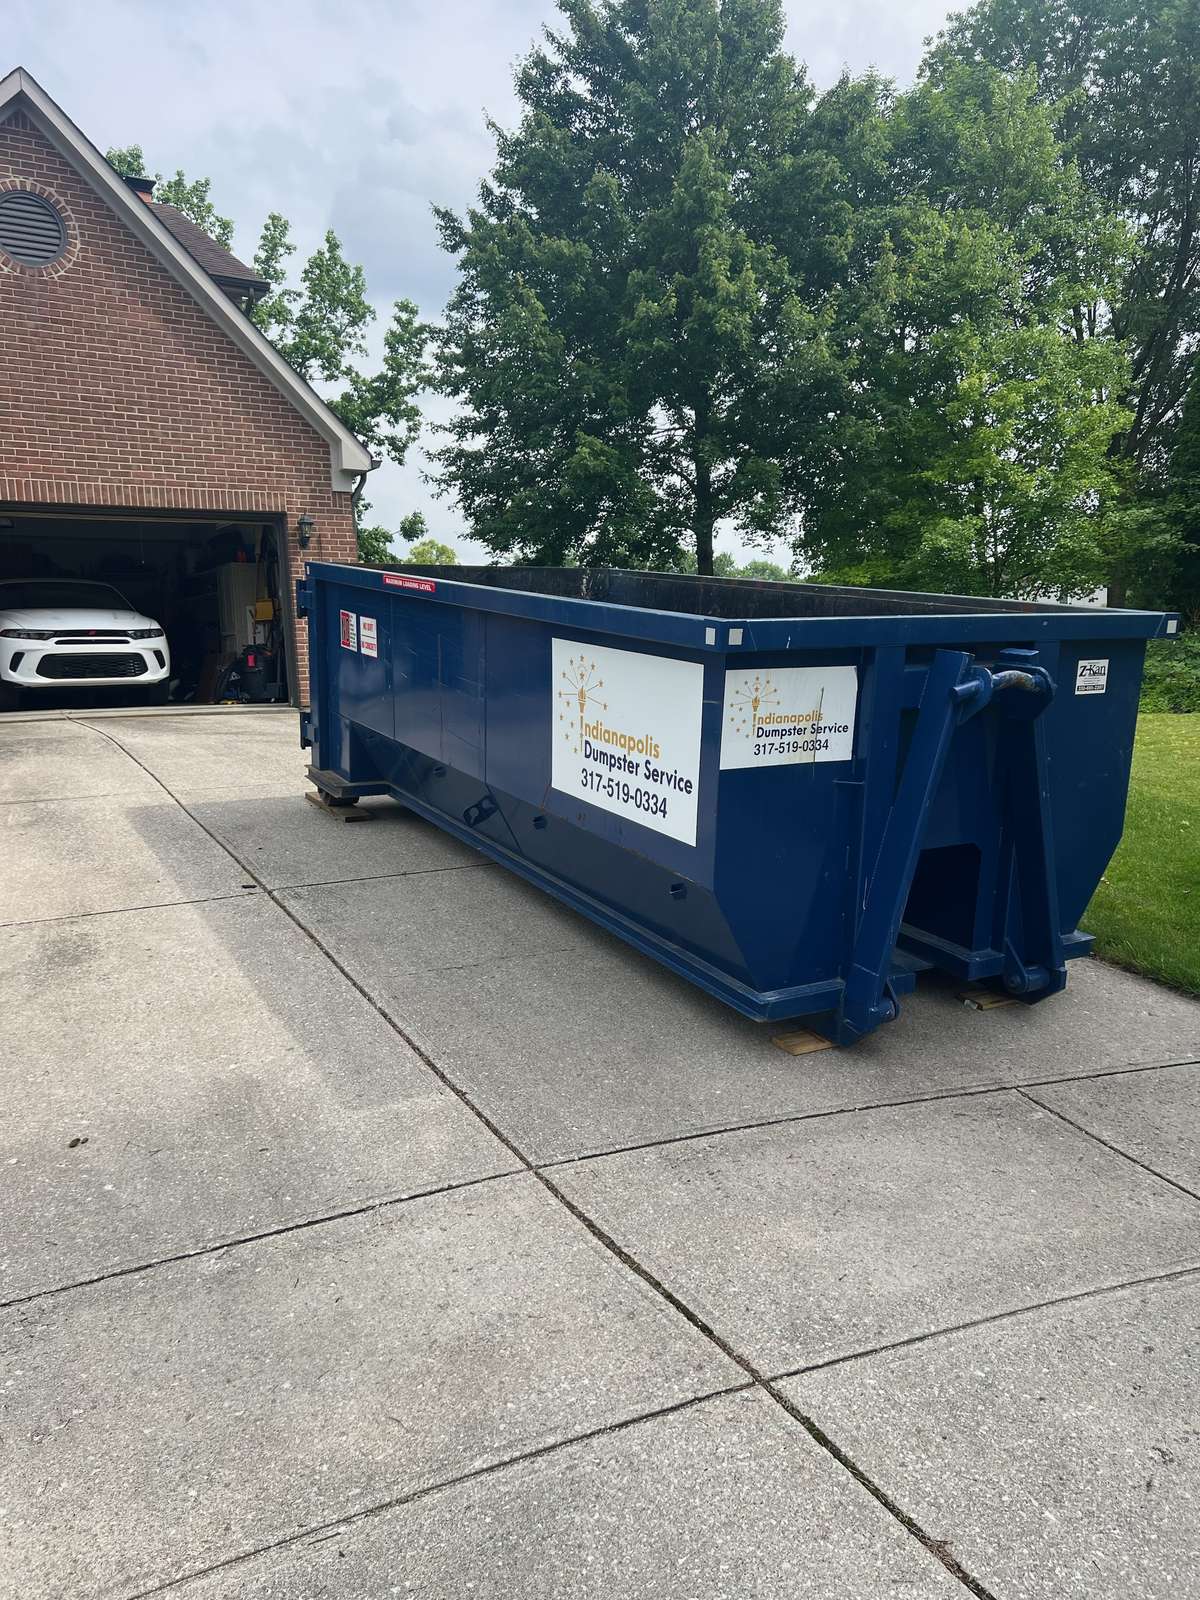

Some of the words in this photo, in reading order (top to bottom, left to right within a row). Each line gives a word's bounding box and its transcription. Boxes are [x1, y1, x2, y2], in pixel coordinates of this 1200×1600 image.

[403, 580, 419, 588] LOADING
[420, 583, 432, 591] LEVEL
[1079, 665, 1106, 677] Z-Kan
[753, 710, 823, 733] Indianapolis
[756, 725, 808, 739] Dumpster
[810, 722, 849, 735] Service
[580, 715, 660, 760] Indianapolis
[753, 739, 829, 756] 317-519-0334
[584, 740, 640, 776] Dumpster
[644, 759, 693, 795] Service
[581, 768, 668, 818] 317-519-0334
